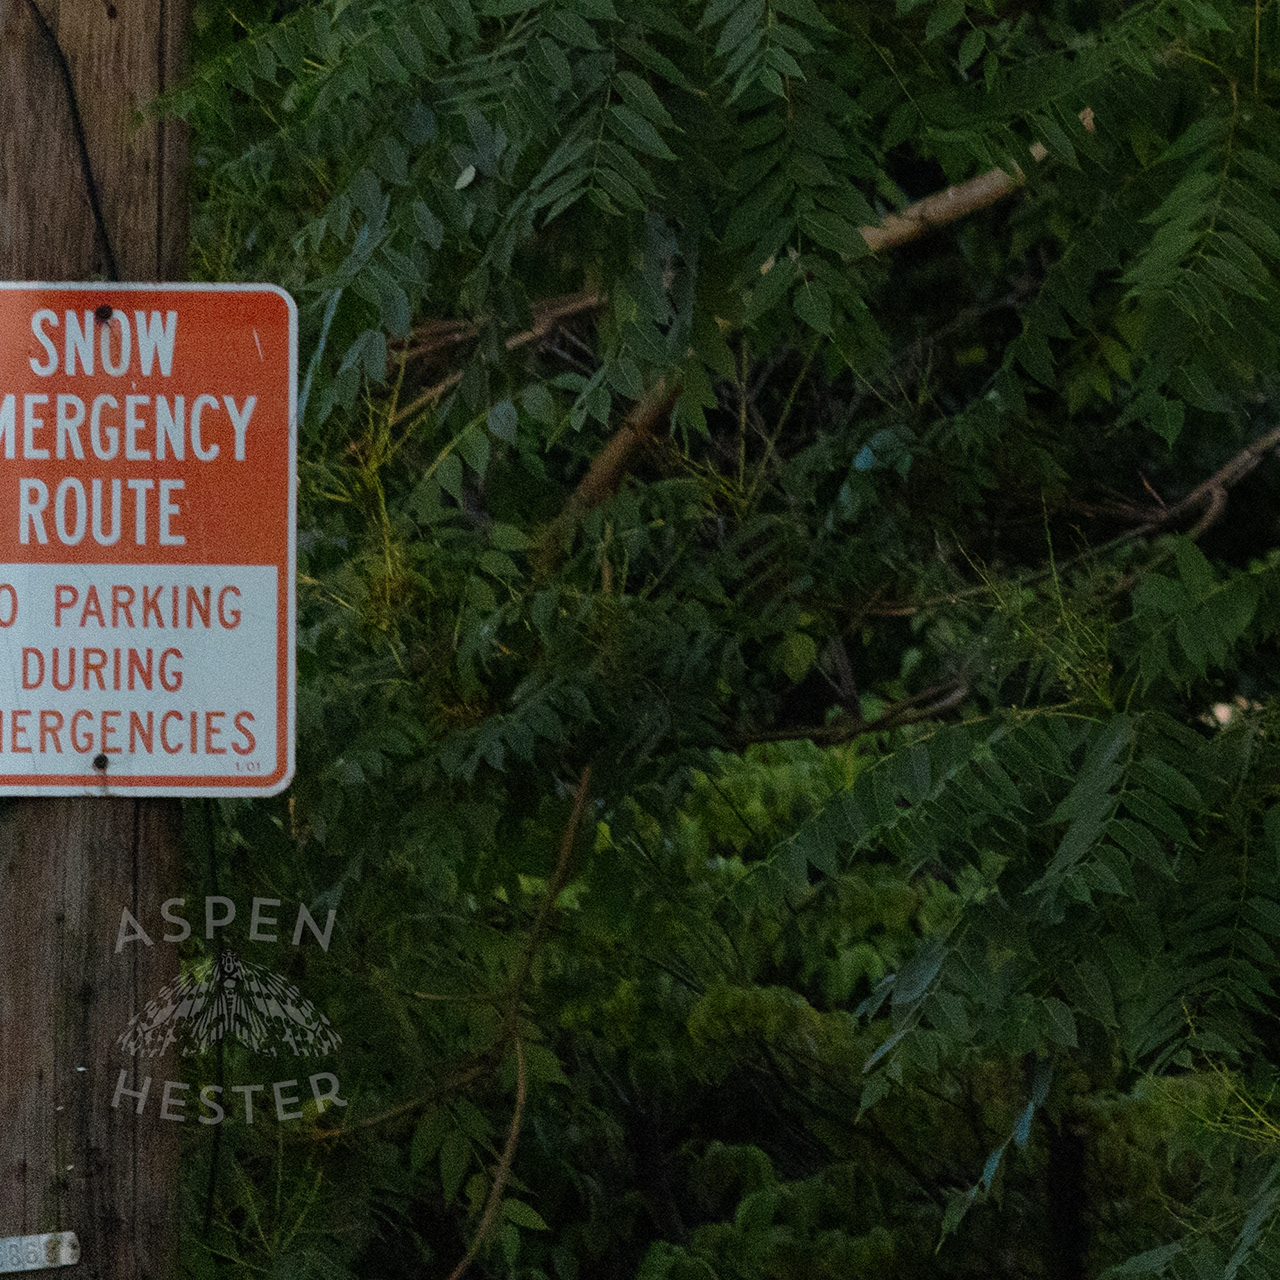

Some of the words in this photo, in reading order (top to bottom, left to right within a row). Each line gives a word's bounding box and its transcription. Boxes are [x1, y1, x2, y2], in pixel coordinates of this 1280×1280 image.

[29, 308, 179, 378] SNOW
[19, 476, 187, 547] ROUTE
[53, 583, 243, 630] PARKING
[21, 646, 185, 693] DURING
[0, 709, 257, 756] ERGENCIES
